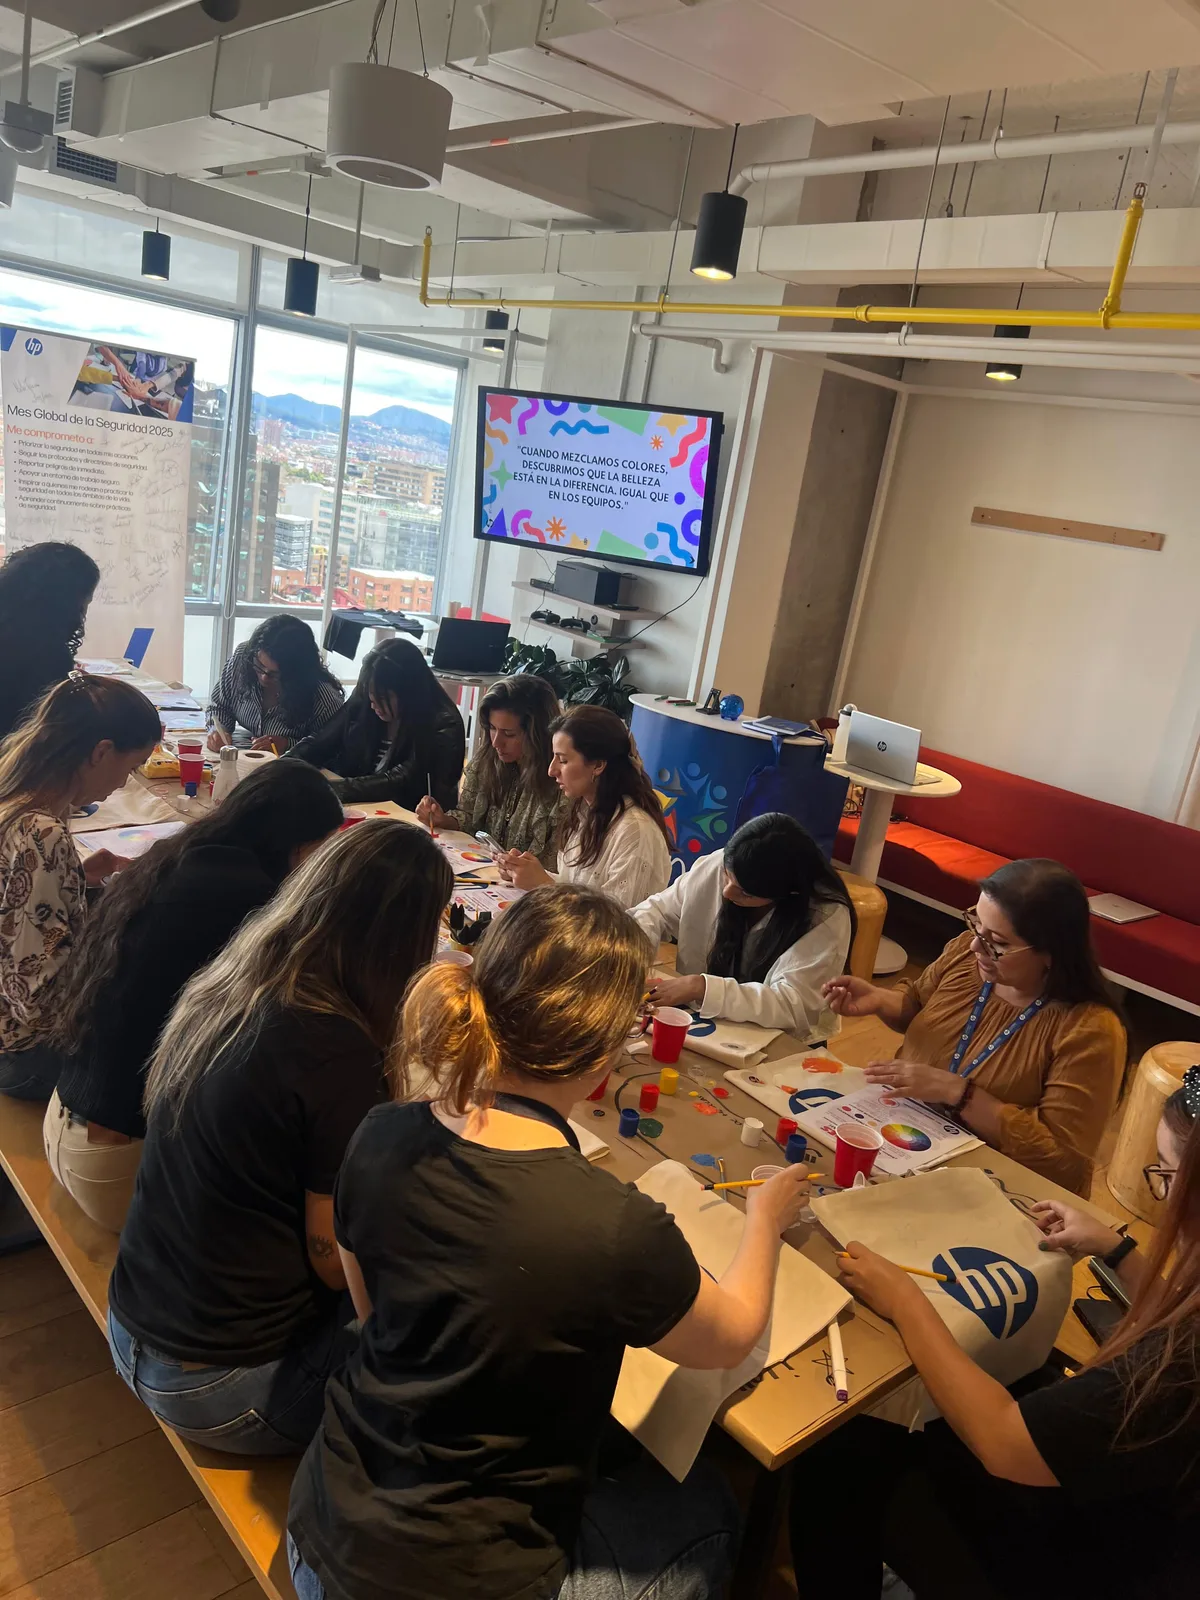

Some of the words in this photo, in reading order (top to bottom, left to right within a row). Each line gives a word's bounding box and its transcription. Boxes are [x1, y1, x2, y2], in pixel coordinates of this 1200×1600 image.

[26, 337, 42, 356] hp
[7, 404, 32, 418] Mes
[33, 408, 68, 422] Global
[69, 414, 83, 424] de
[85, 416, 94, 426] la
[96, 417, 148, 432] Seguridad
[149, 425, 174, 438] 2025
[6, 424, 22, 435] Me
[24, 428, 85, 444] comprometo
[18, 440, 43, 449] Priorizar
[50, 444, 78, 452] seguridad
[18, 450, 38, 458] Seguir
[48, 454, 78, 463] protocolos
[83, 458, 112, 466] directrices
[18, 459, 44, 468] Reportar
[46, 463, 68, 471] peligros
[516, 445, 560, 460] "CUANDO
[561, 452, 620, 468] MEZCLAMOS
[621, 459, 668, 475] COLORES,
[18, 469, 40, 477] Apoyar
[80, 476, 100, 484] trabajo
[522, 460, 585, 477] DESCUBRIMOS
[586, 468, 606, 482] QUE
[608, 472, 620, 482] LA
[621, 474, 661, 488] BELLEZA
[18, 478, 40, 486] Inspirar
[46, 482, 68, 490] quienes
[104, 488, 128, 496] practicar
[513, 469, 534, 484] ESTÁ
[536, 474, 548, 485] EN
[549, 477, 561, 487] LA
[562, 478, 617, 495] DIFERENCIA.
[619, 487, 647, 500] IGUAL
[649, 492, 669, 502] QUE
[18, 495, 46, 503] Aprender
[46, 498, 88, 508] continuamente
[548, 490, 560, 500] EN
[562, 492, 580, 504] LOS
[581, 496, 629, 510] EQUIPOS."
[936, 1249, 1032, 1340] hp
